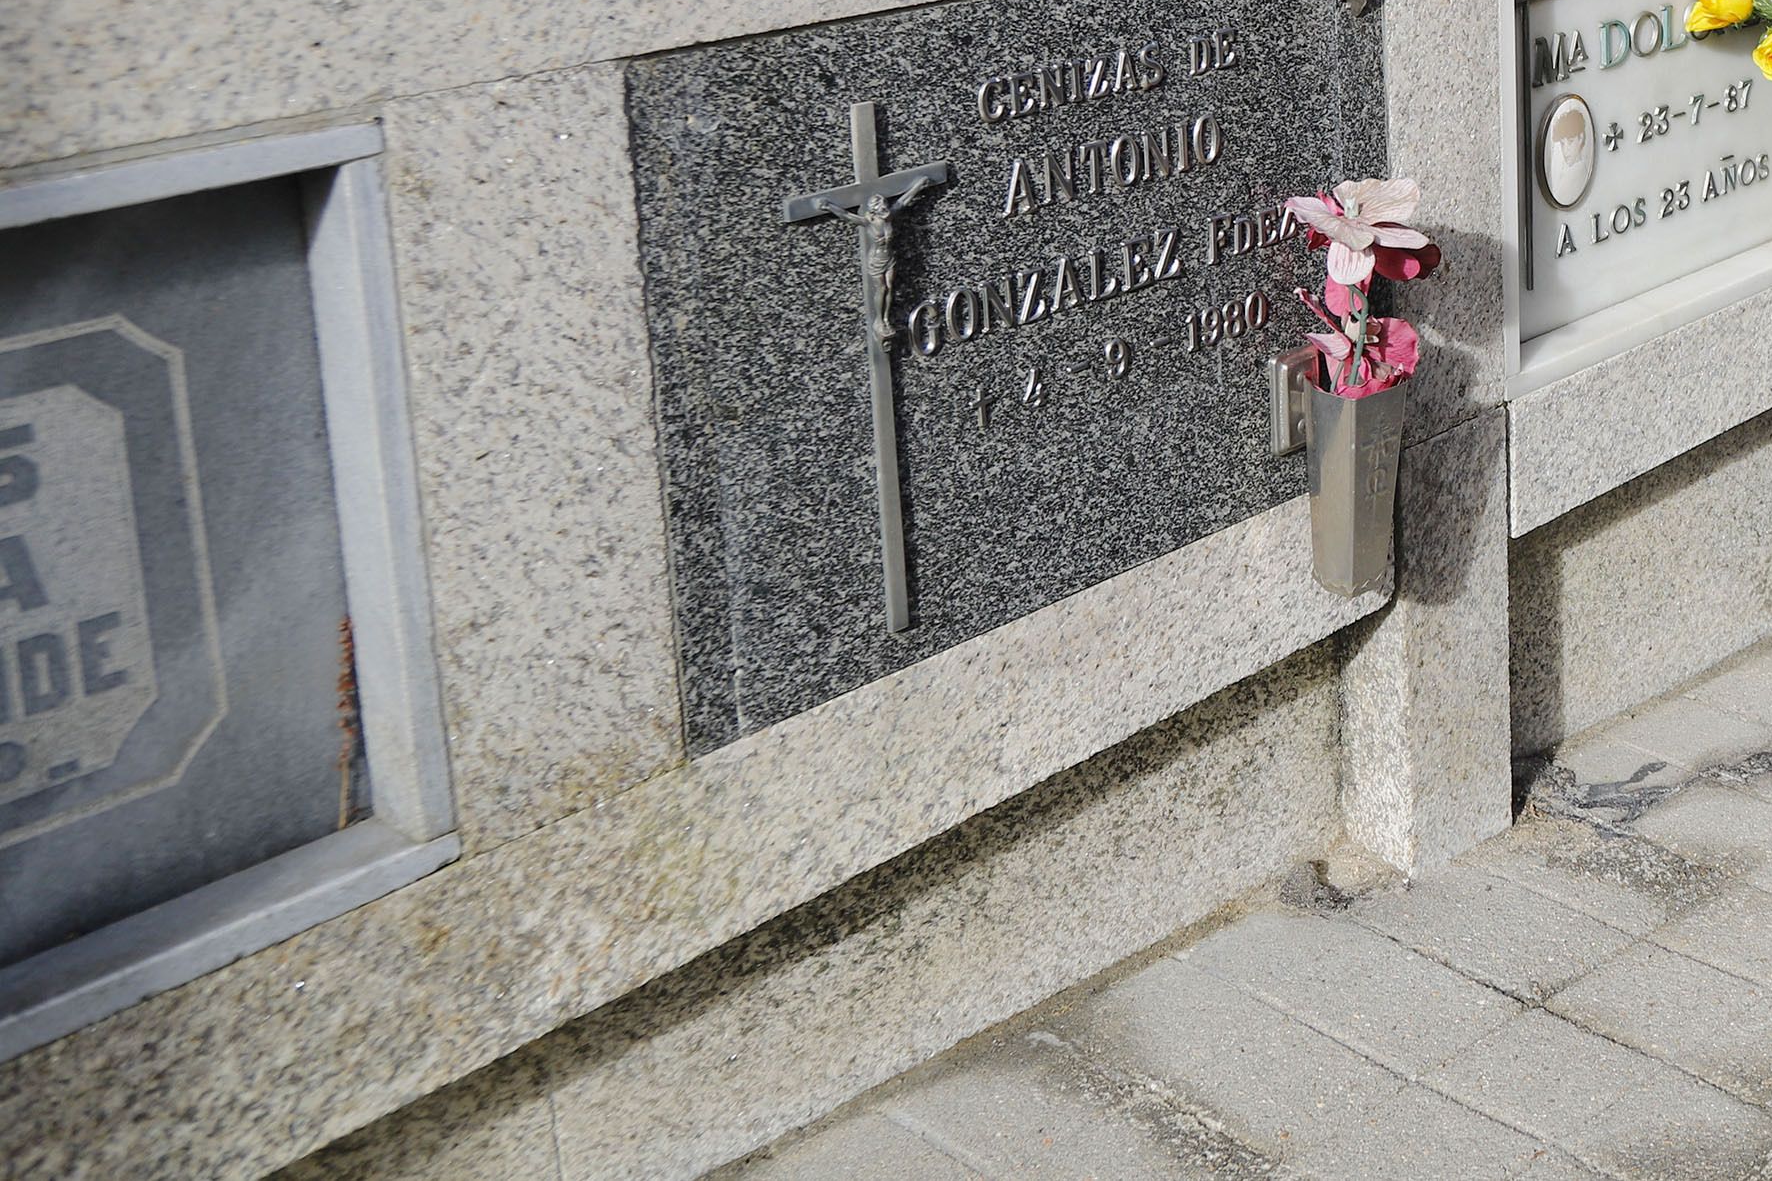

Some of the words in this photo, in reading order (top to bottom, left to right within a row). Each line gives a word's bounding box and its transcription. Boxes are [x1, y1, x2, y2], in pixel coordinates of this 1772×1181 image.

[977, 40, 1165, 123] CENIZAS
[1188, 27, 1237, 76] DE
[1002, 115, 1223, 218] ANTONIO
[1555, 222, 1577, 259] A
[1589, 196, 1648, 245] LOS
[1657, 179, 1691, 220] 23
[1702, 154, 1770, 203] AÑOS
[908, 227, 1186, 358] GONZALEZ
